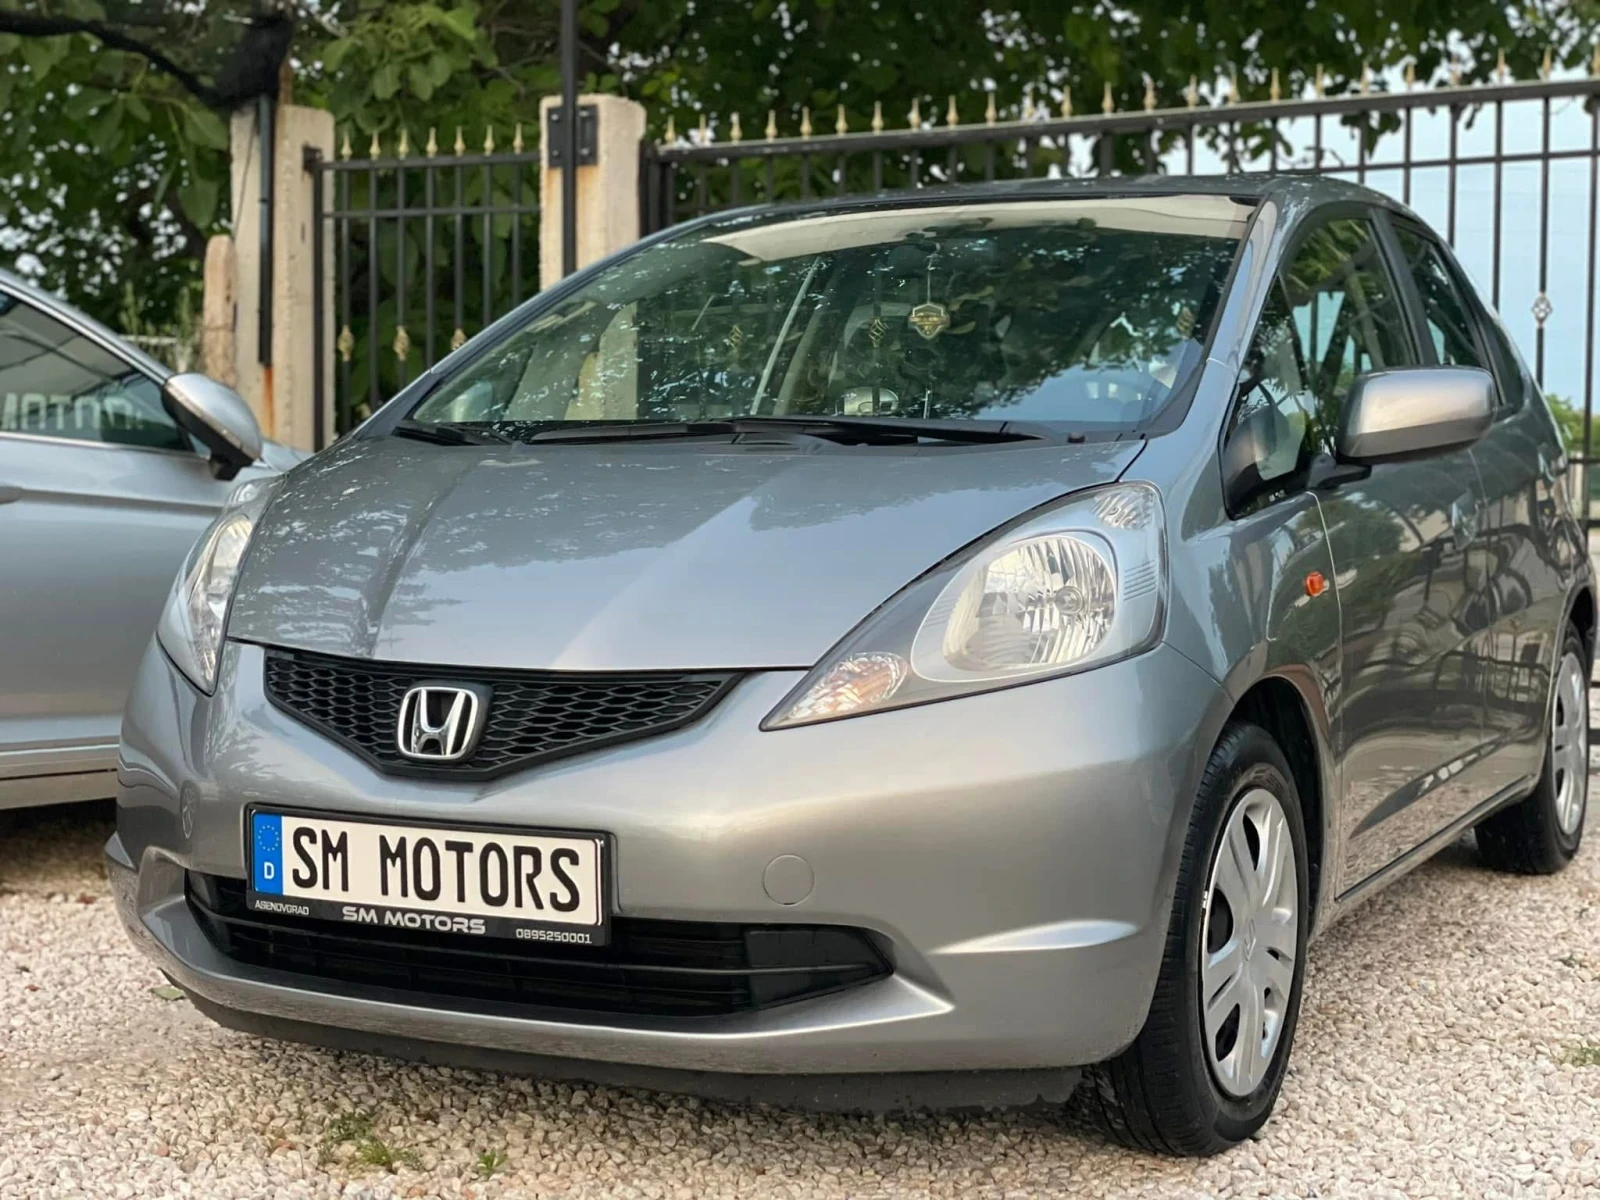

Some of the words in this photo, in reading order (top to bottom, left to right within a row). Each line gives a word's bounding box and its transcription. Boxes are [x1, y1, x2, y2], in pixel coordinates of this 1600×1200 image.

[292, 826, 349, 892] SM
[379, 834, 580, 912] MOTORS
[254, 900, 310, 916] ASENOVGRAD
[342, 906, 378, 924] SM
[384, 910, 487, 935] MOTORS
